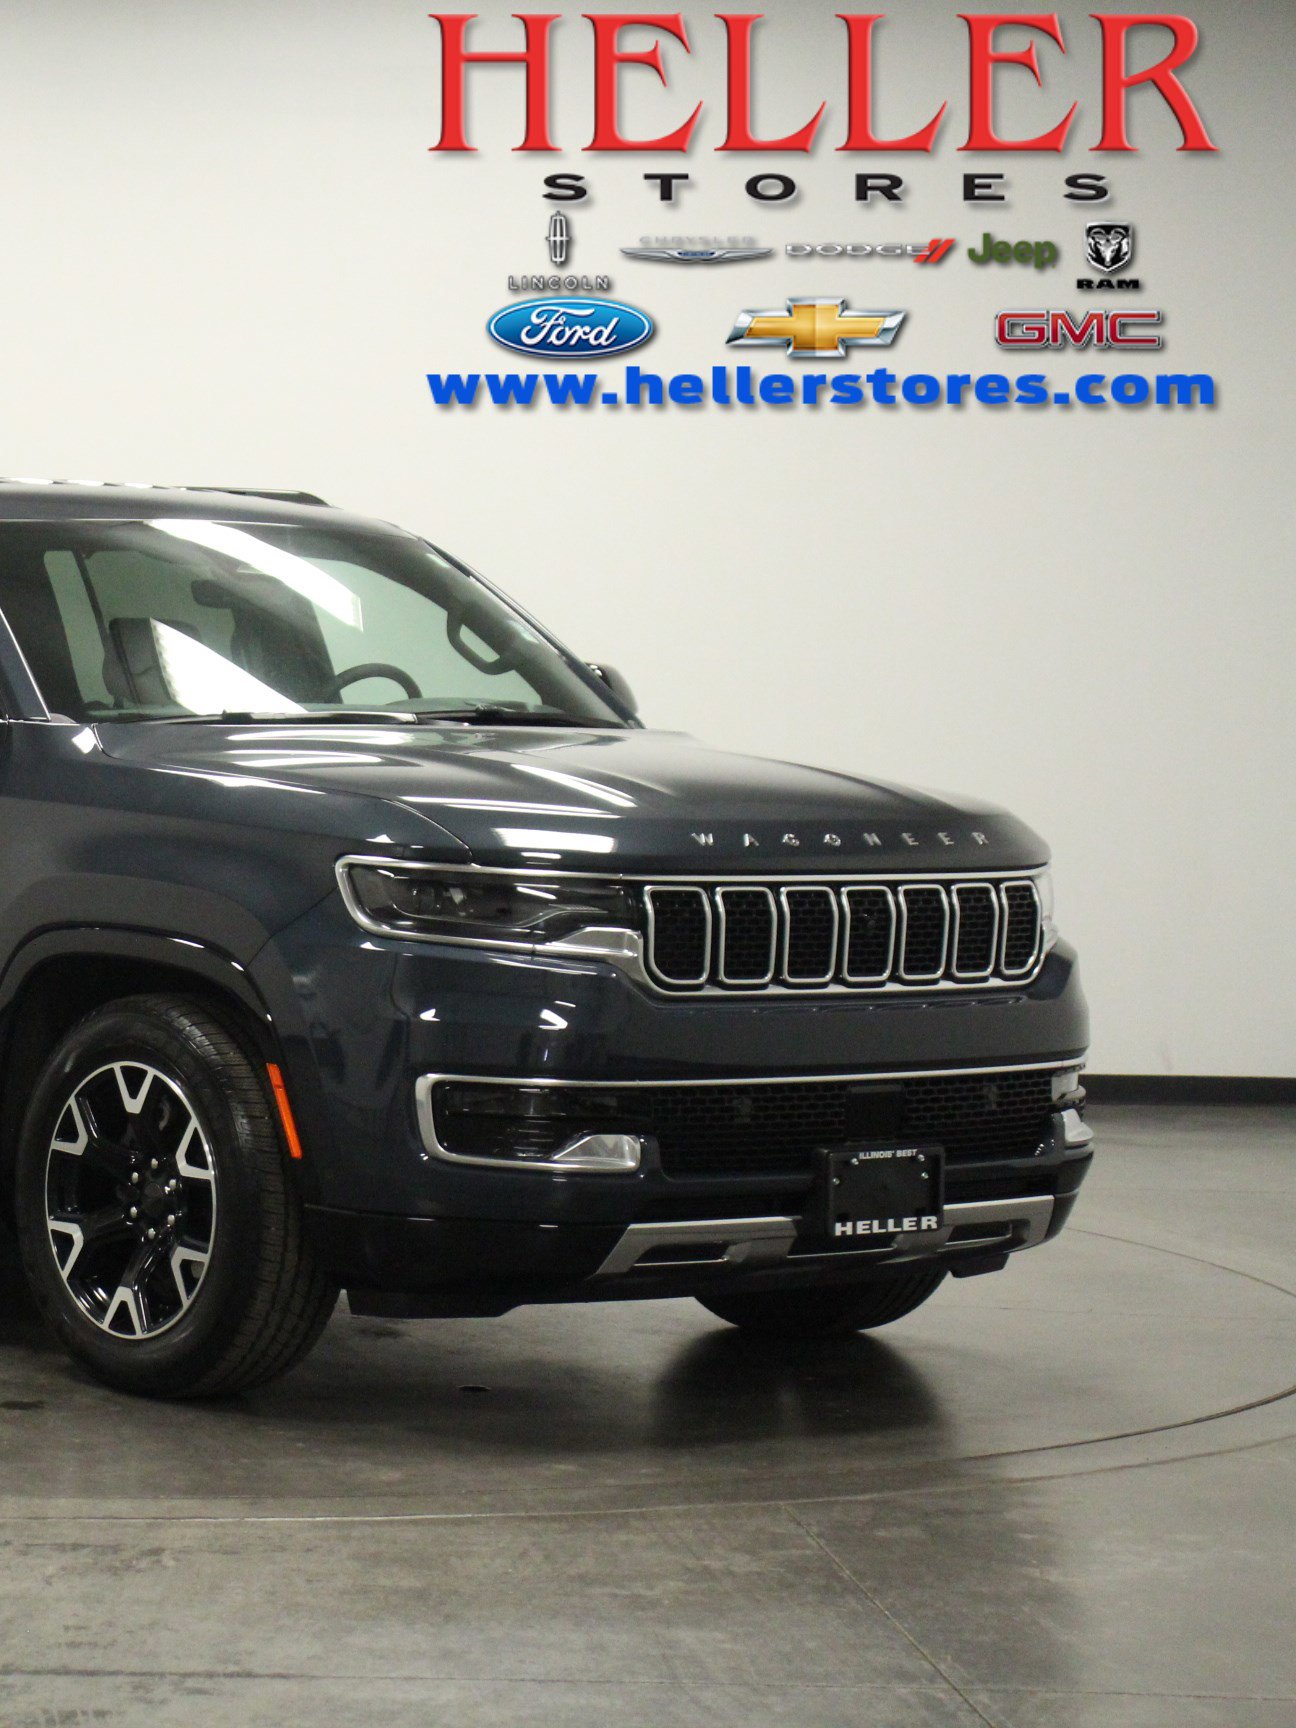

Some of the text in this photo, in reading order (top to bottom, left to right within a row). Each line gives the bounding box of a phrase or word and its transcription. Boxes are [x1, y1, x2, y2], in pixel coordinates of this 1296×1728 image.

[691, 831, 990, 847] WAGONEER
[896, 1149, 918, 1157] BEST
[835, 1215, 938, 1236] HELLER
